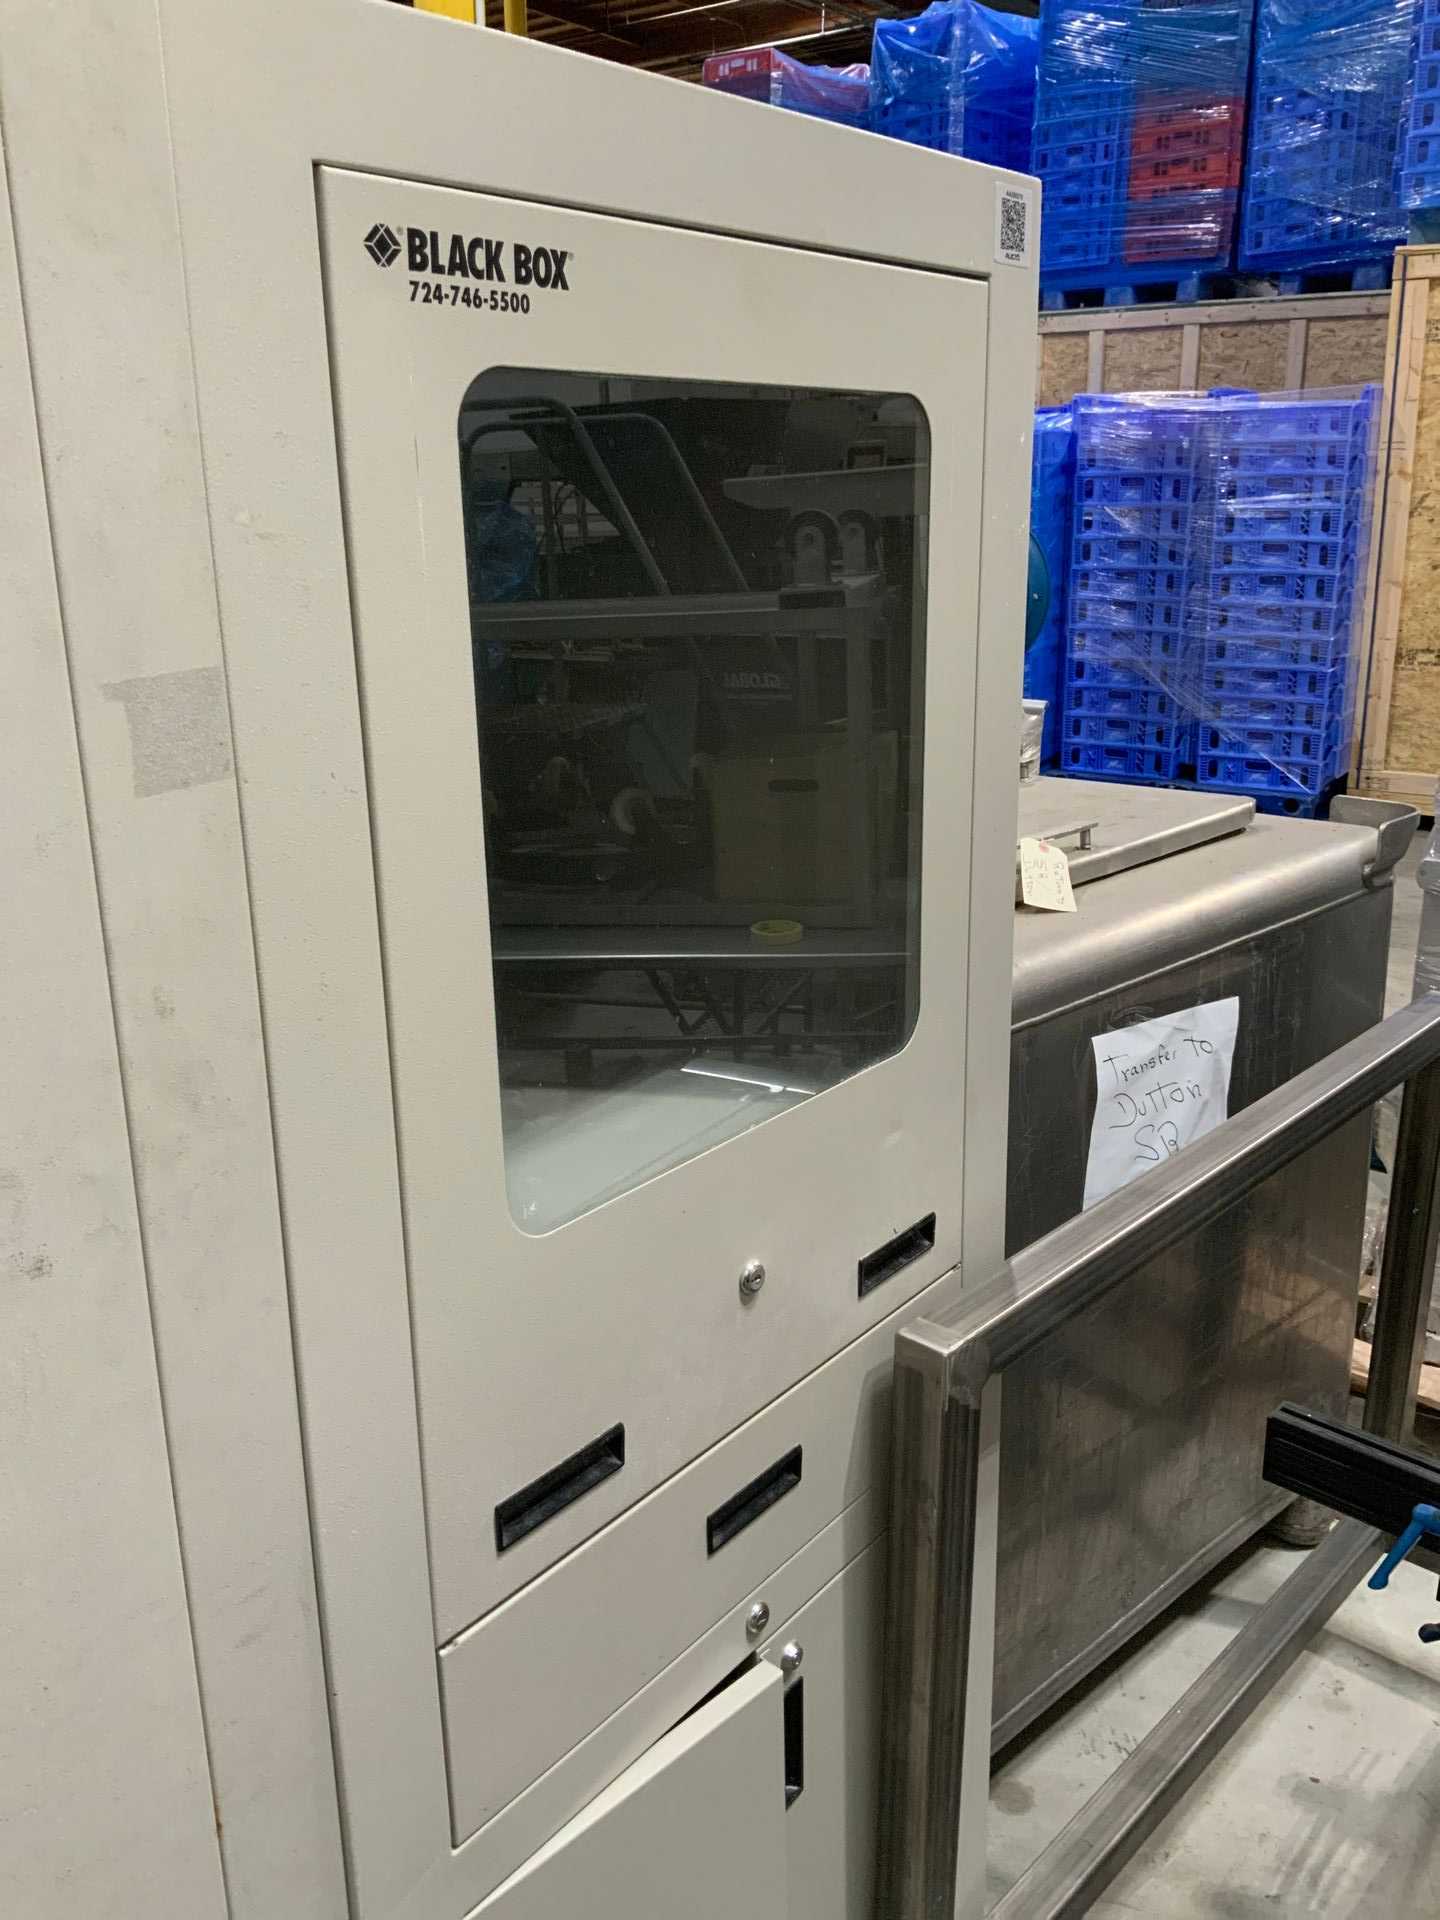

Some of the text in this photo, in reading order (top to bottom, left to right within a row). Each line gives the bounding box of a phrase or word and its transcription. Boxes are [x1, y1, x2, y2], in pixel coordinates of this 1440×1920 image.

[407, 227, 569, 290] BLACK BOX
[409, 281, 530, 314] 724-746-5500
